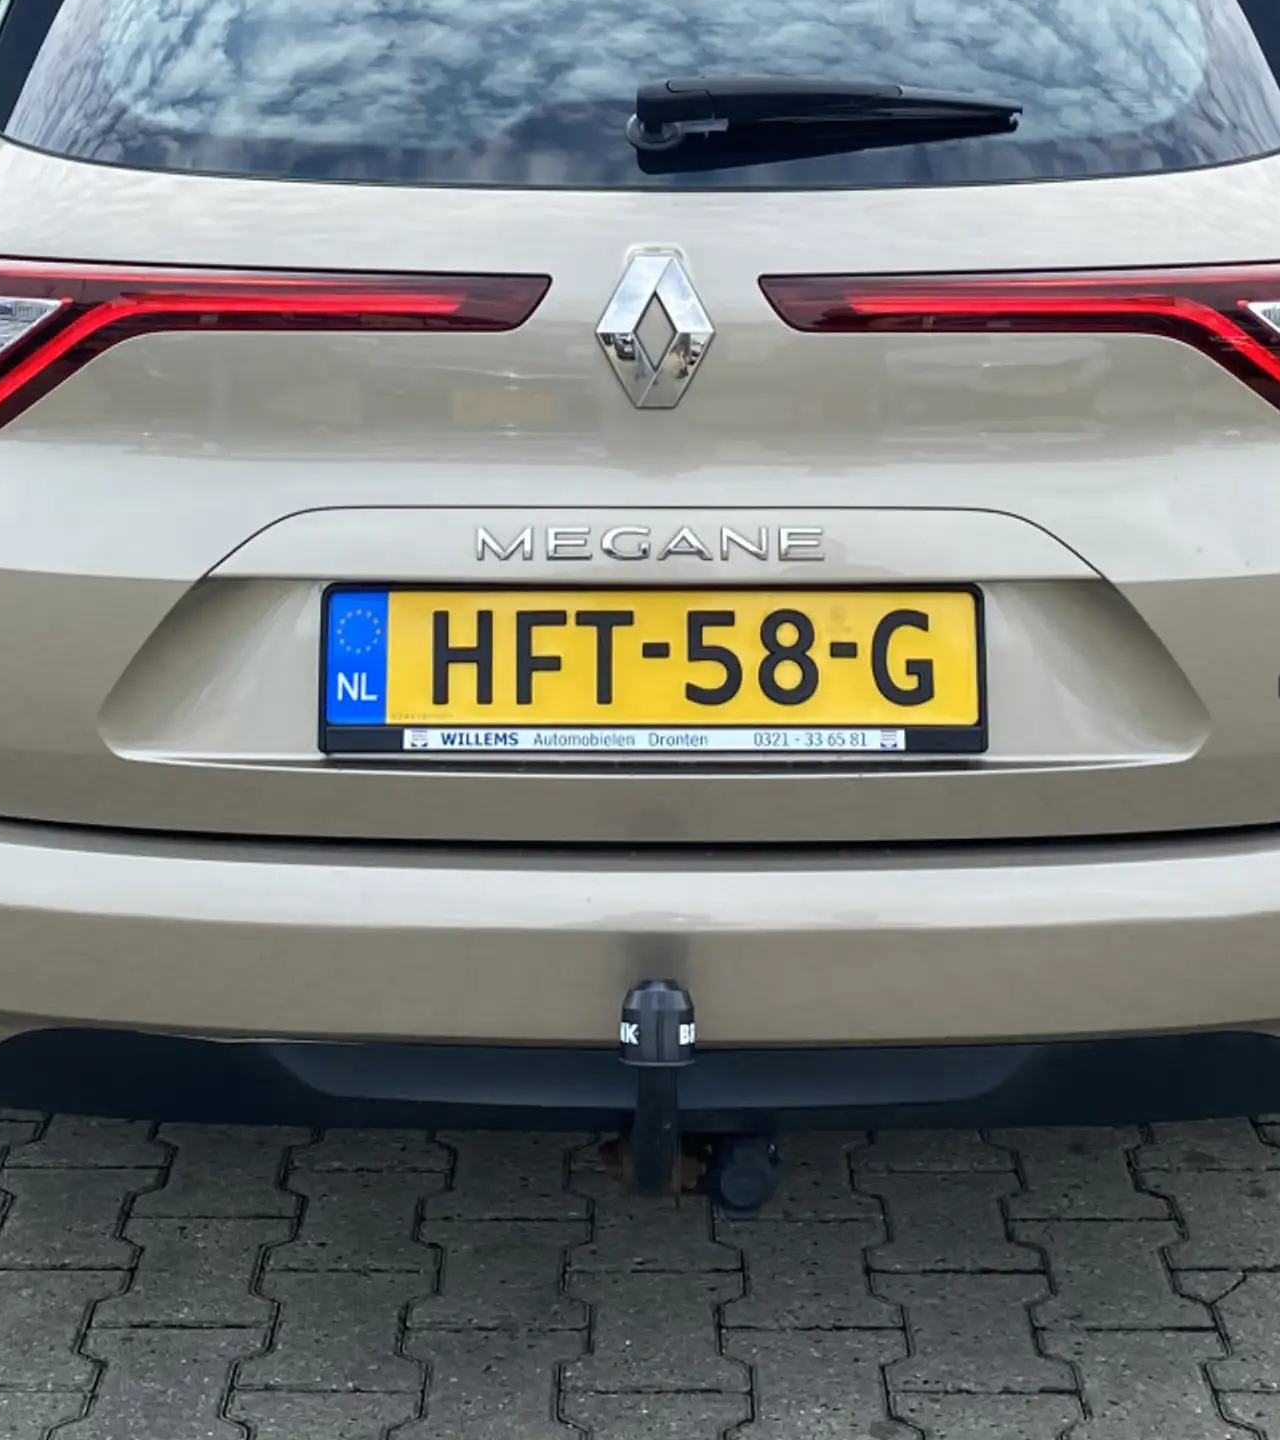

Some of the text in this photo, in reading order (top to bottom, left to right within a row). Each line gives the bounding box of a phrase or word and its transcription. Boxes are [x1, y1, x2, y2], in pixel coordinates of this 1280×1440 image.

[474, 526, 827, 562] MEGANE
[431, 609, 936, 707] HFT-58-G
[336, 673, 378, 703] NL
[439, 731, 520, 747] WILLEMS
[533, 731, 636, 748] Automobielen
[647, 731, 709, 748] Dronten
[753, 731, 789, 748] 0321
[806, 731, 824, 748] 33
[827, 731, 846, 748] 65
[849, 731, 868, 748] 81
